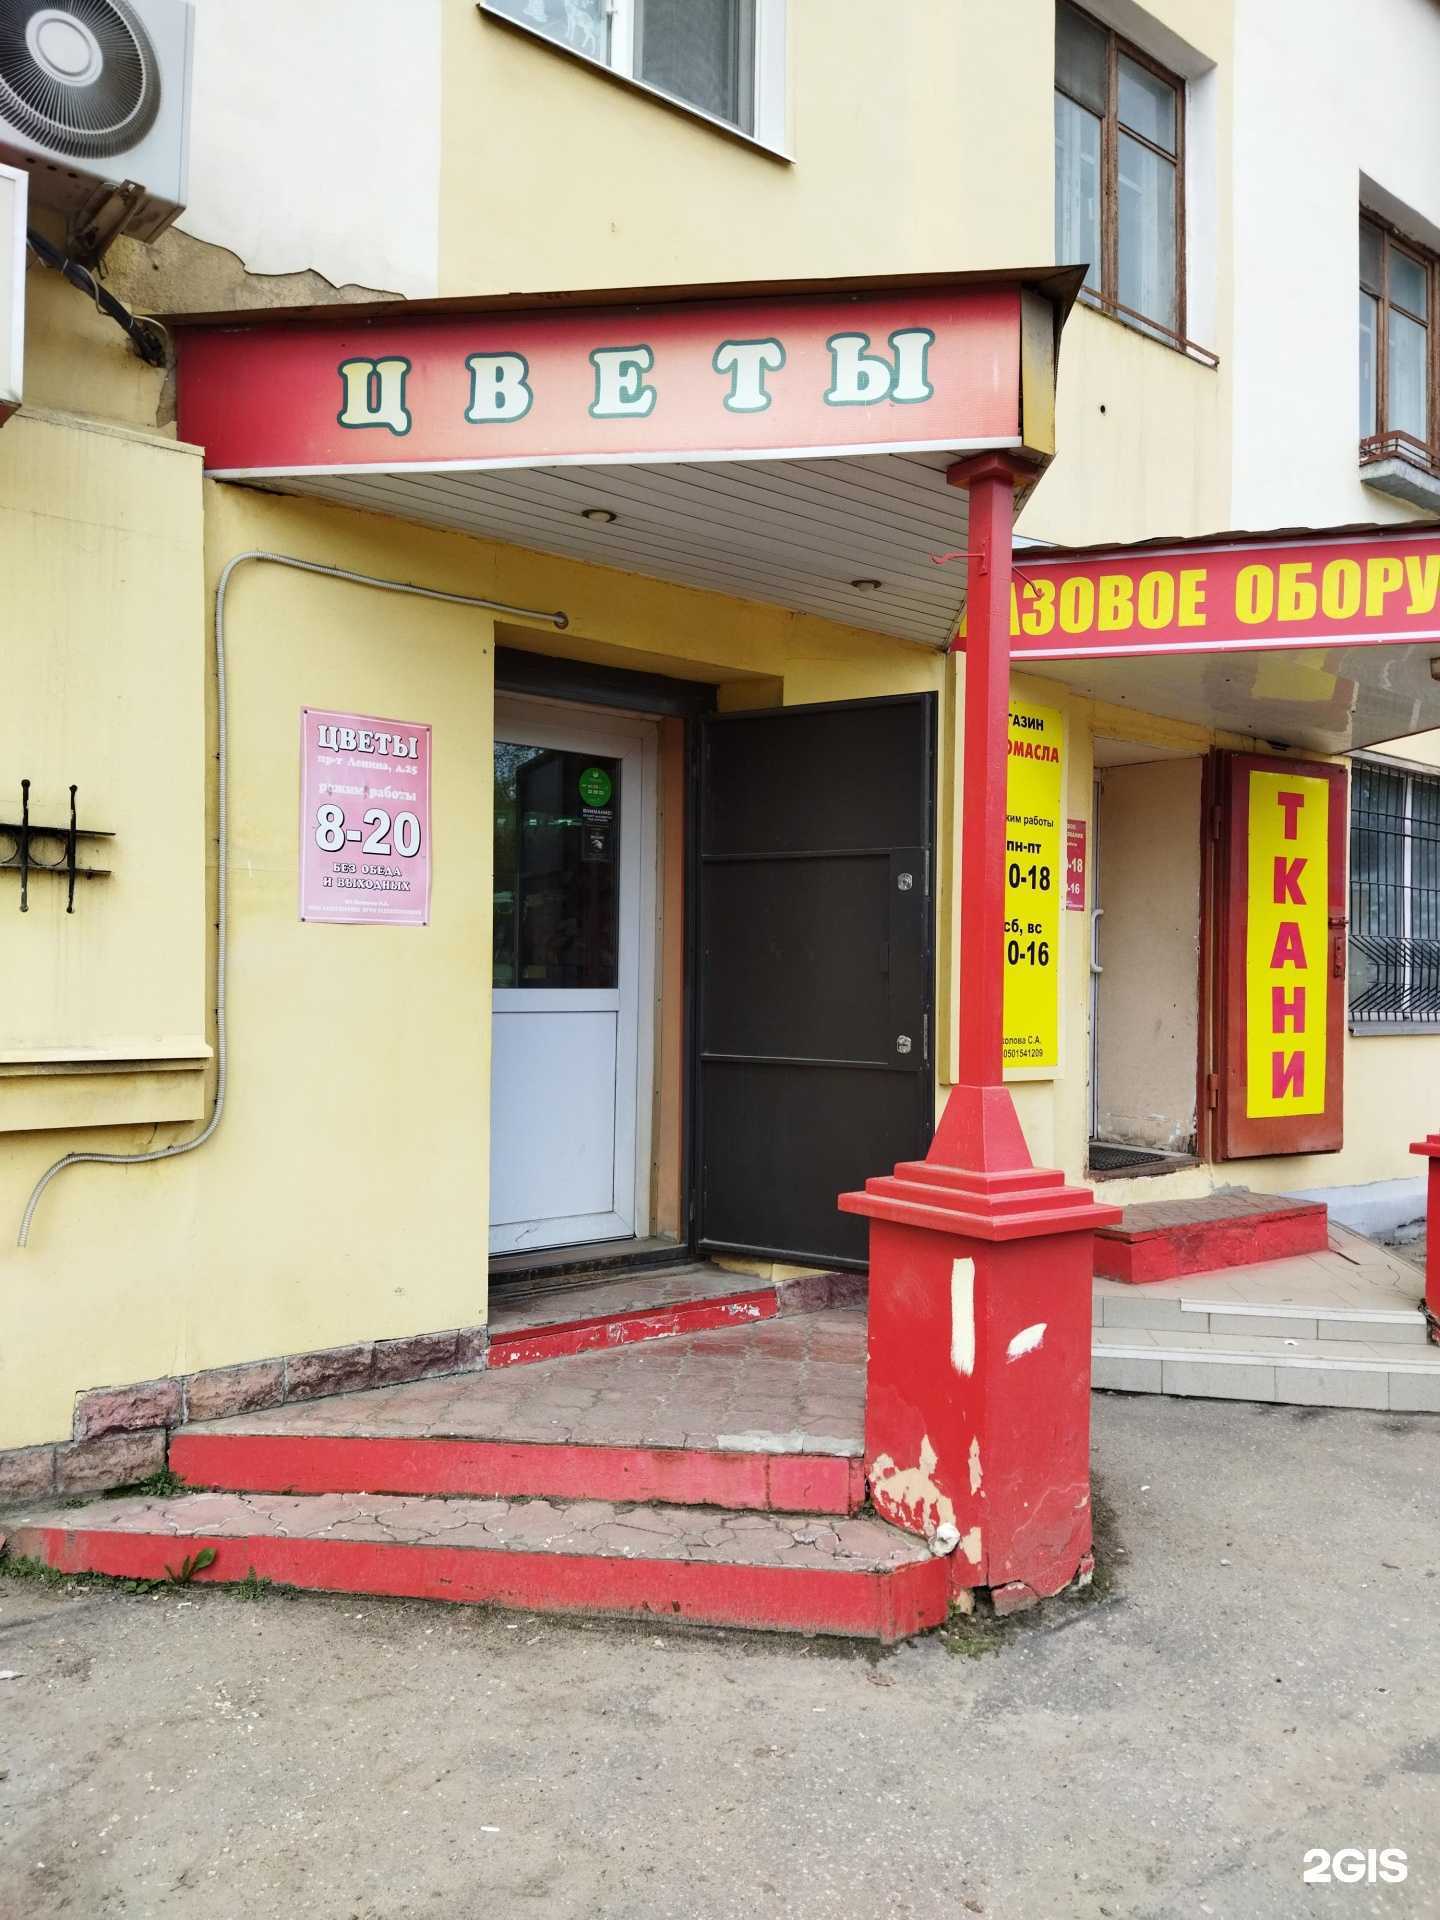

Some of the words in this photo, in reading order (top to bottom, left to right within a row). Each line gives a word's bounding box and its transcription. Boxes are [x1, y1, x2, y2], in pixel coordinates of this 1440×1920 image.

[337, 327, 935, 436] ЦВЕТЫ
[959, 569, 1207, 638] ЗОВОЕ
[317, 725, 418, 759] ЦВЕТЫ
[368, 785, 417, 801] работы
[315, 803, 421, 858] 8-20
[1023, 816, 1054, 828] работы
[1006, 840, 1042, 854] пн-пт
[332, 863, 357, 874] БЕЗ
[361, 864, 402, 877] ОБЕДА
[1008, 862, 1051, 891] 0-18
[322, 877, 333, 887] И
[337, 878, 411, 892] ВЫХОДНЫХ
[1027, 923, 1042, 934] вс
[1008, 940, 1049, 966] 0-16
[1269, 791, 1308, 1099] ТКАНИ
